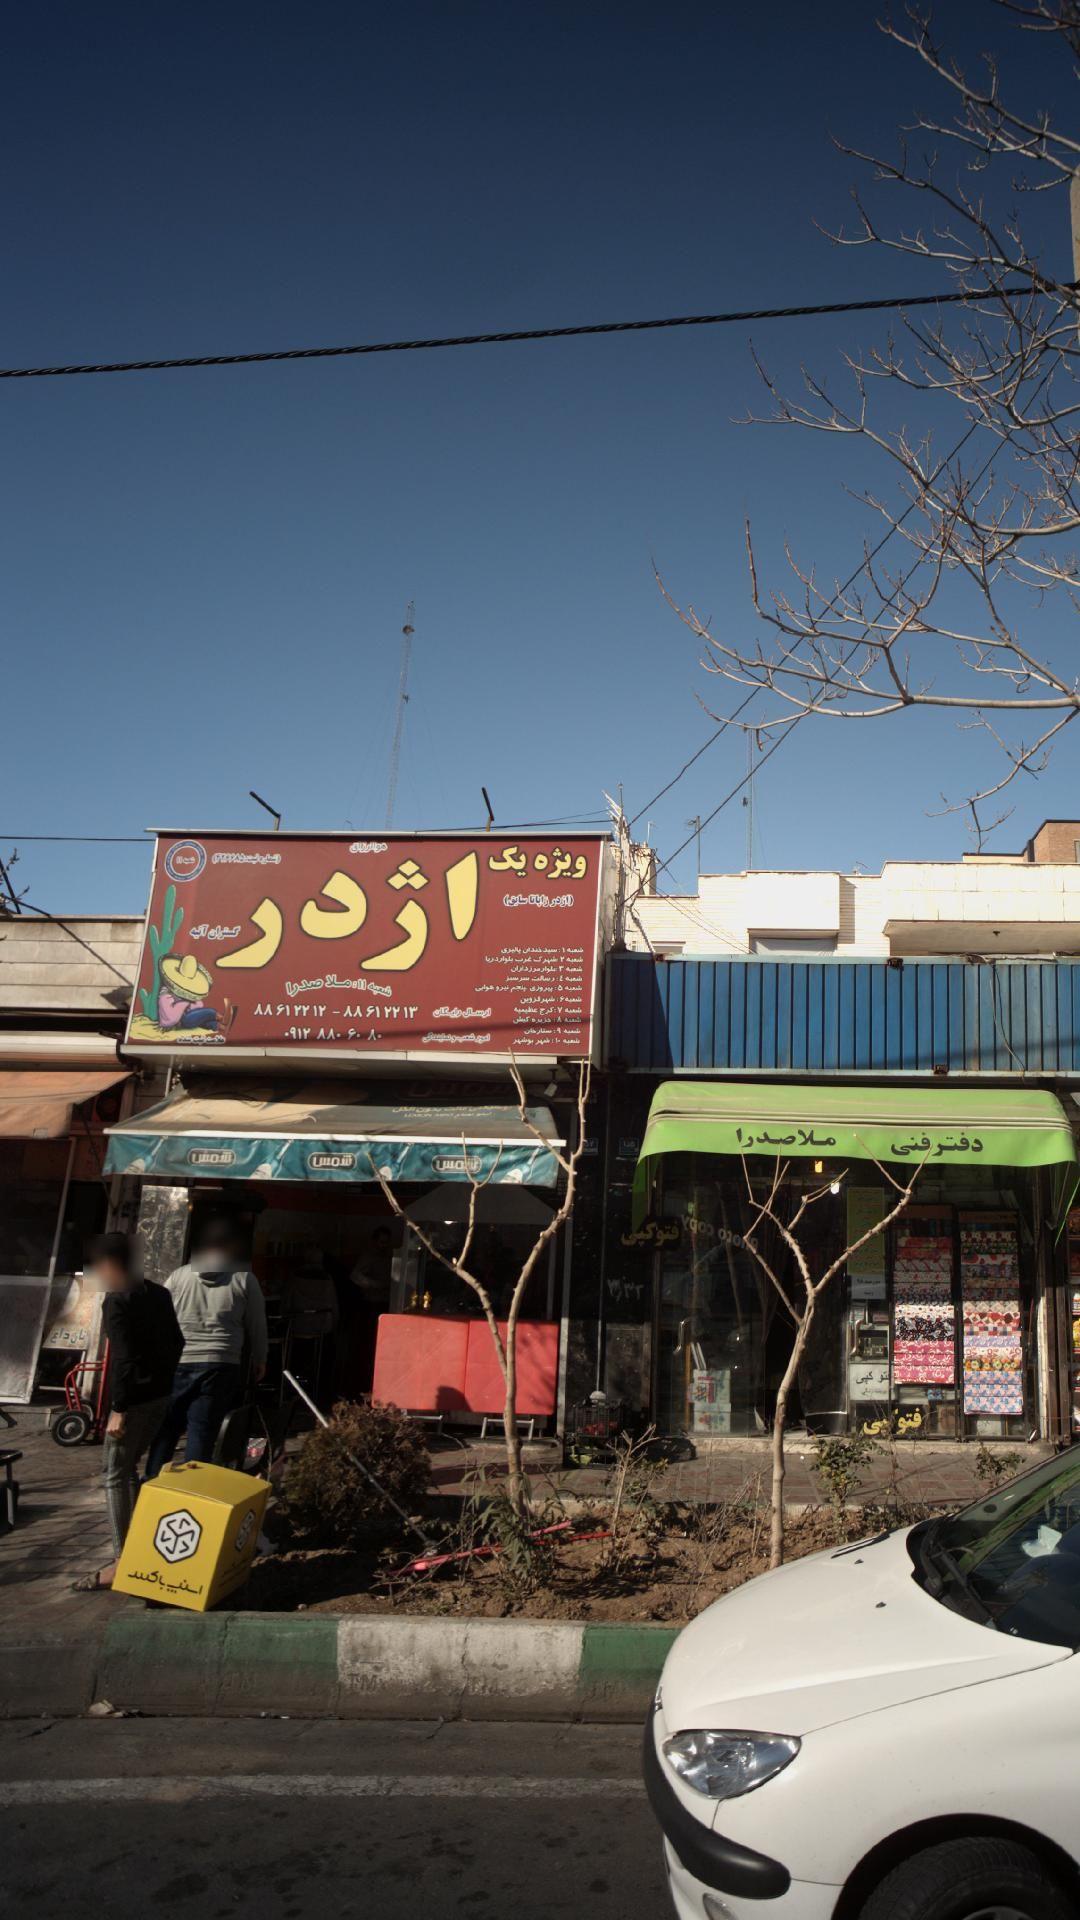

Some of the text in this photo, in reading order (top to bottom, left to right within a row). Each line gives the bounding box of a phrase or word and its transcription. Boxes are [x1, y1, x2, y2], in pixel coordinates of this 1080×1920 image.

[489, 846, 587, 879] ویژه یک
[215, 850, 480, 971] اژدر
[567, 946, 584, 955] شعبه
[566, 956, 583, 964] شعبه
[566, 966, 583, 974] شعبه
[565, 975, 583, 983] شعبه
[368, 982, 392, 997] شعبه
[529, 985, 553, 993] پیروزی
[564, 985, 582, 993] شعبه
[463, 1007, 492, 1018] ارسال
[565, 1006, 582, 1015] شعبه
[564, 1017, 581, 1025] شعبه
[563, 1027, 581, 1035] شعبه
[512, 1037, 534, 1045] بوشهر
[535, 1037, 550, 1045] شهر
[563, 1037, 580, 1045] شعبه
[191, 1151, 233, 1164] شمس
[313, 1153, 352, 1167] شمس
[435, 1157, 480, 1171] شمس
